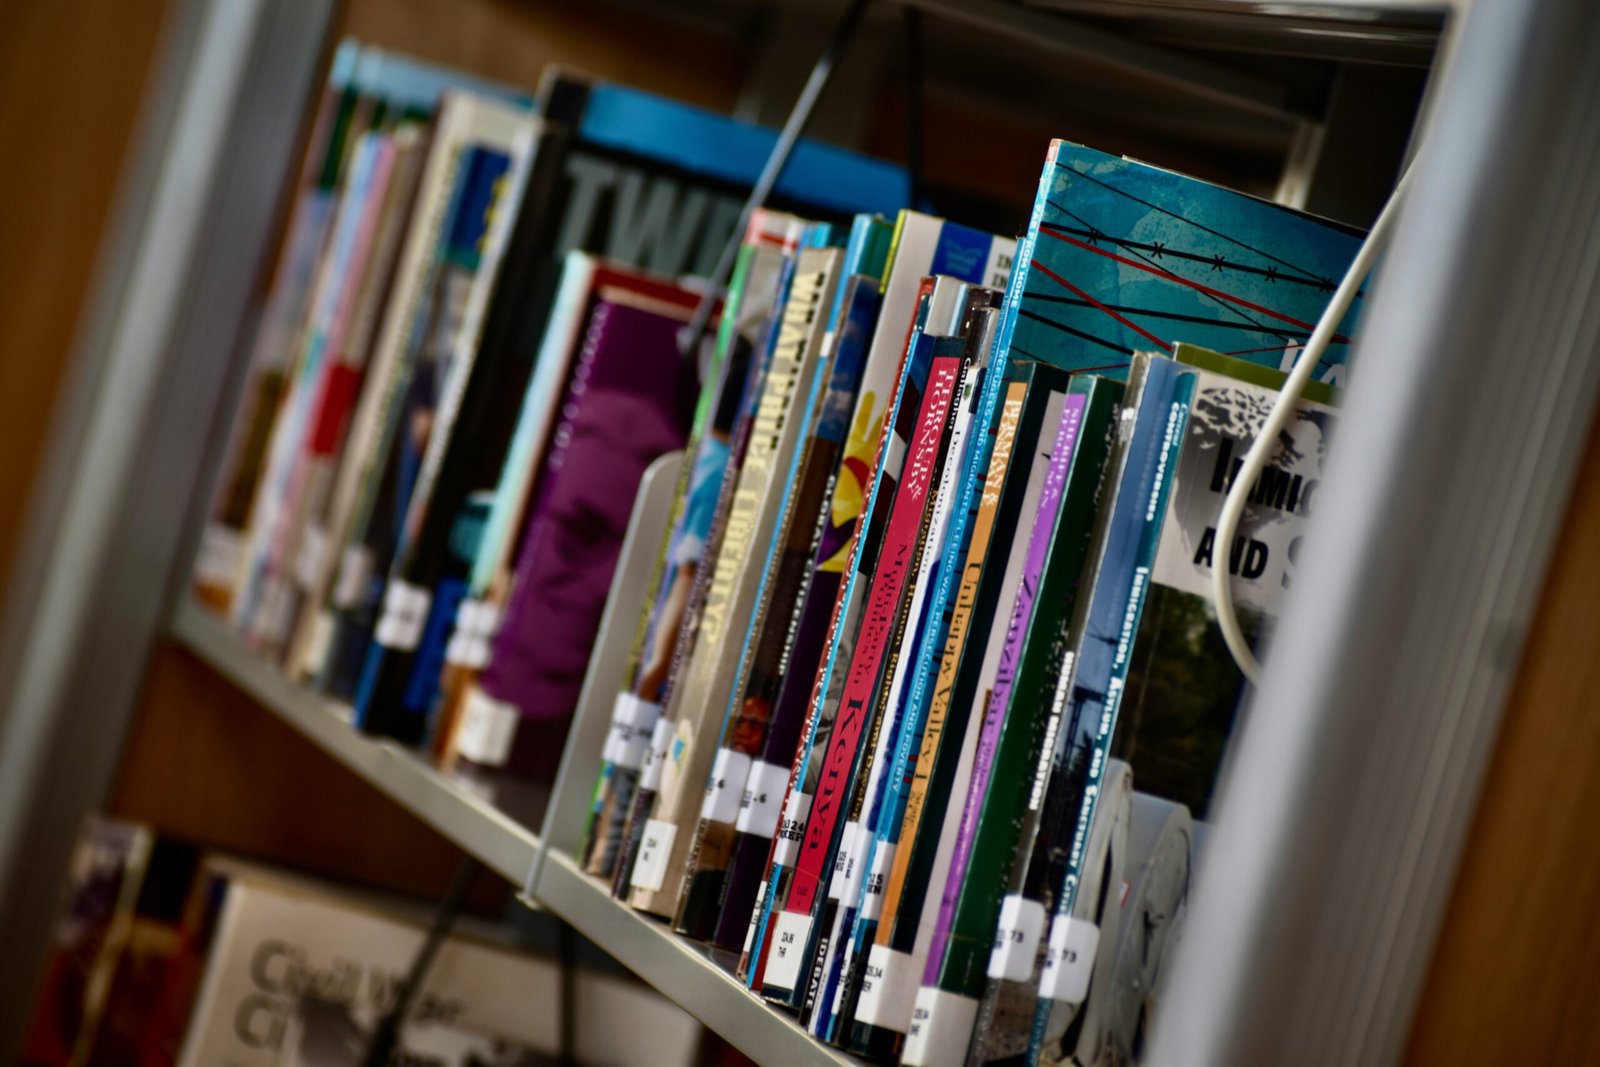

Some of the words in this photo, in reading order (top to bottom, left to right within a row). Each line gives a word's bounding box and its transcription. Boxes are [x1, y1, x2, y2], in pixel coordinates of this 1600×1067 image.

[1010, 271, 1024, 308] HOME
[1020, 232, 1035, 269] FROM
[948, 357, 971, 429] Gallagher
[984, 350, 1005, 416] REFUGEES
[906, 368, 947, 491] HORNSBY
[917, 366, 956, 480] THROUP
[976, 419, 988, 446] AND
[1145, 401, 1179, 522] CONTROVERSIES
[809, 474, 835, 551] GLOBAL
[920, 430, 960, 573] Decolonization
[959, 449, 980, 515] MIGRANTS
[945, 518, 963, 573] FLEEING
[777, 558, 813, 674] CITIZENSHIP
[862, 543, 907, 675] Multi-Party
[894, 583, 916, 646] Human
[938, 560, 981, 679] Unhappy
[1113, 565, 1149, 670] IMMIGRATION,
[913, 612, 940, 700] PERSECUTION
[983, 572, 1037, 734] Zanzibar
[1051, 649, 1074, 713] HUMAN
[905, 703, 917, 731] AND
[918, 683, 951, 763] Valley
[1096, 675, 1122, 741] ASYLUM,
[804, 695, 864, 853] Kenya
[893, 734, 910, 791] POVERTY
[1028, 714, 1059, 810] MIGRATION
[1069, 784, 1098, 867] SANCTUARY
[805, 937, 828, 1009] IDEBATE
